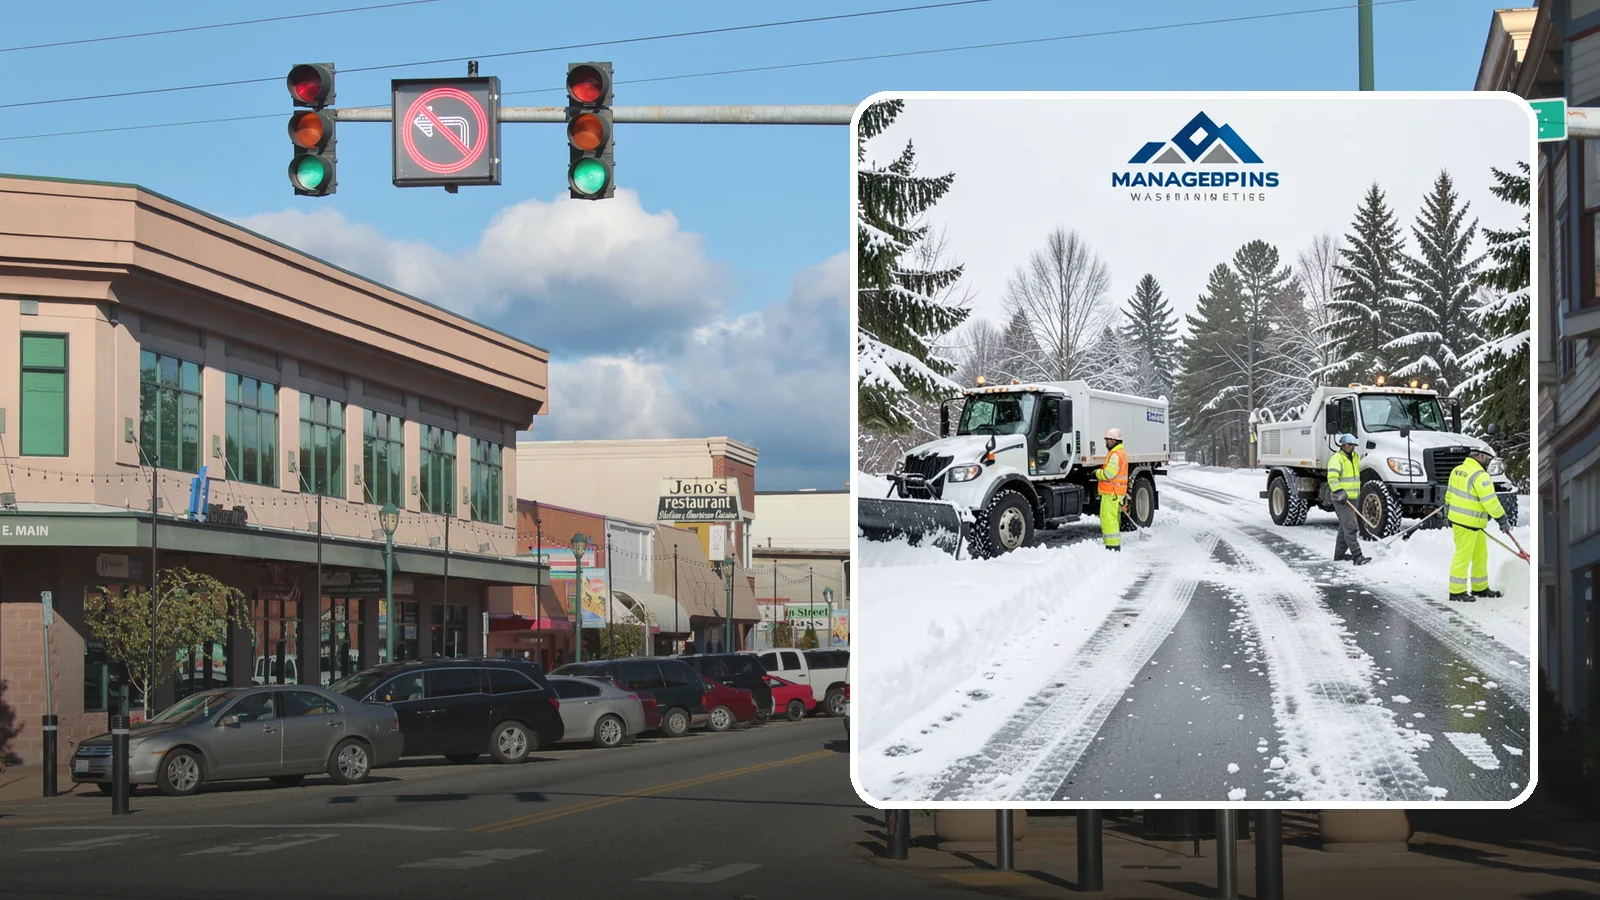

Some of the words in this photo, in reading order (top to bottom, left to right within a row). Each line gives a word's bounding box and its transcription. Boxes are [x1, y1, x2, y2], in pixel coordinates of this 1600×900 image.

[669, 479, 728, 495] Jeno's
[665, 496, 731, 509] restaurant
[658, 509, 682, 519] Italian
[686, 509, 715, 519] American
[715, 509, 738, 519] Cuisine
[2, 525, 13, 536] E.
[15, 525, 49, 536] MAIN
[797, 607, 828, 617] Street
